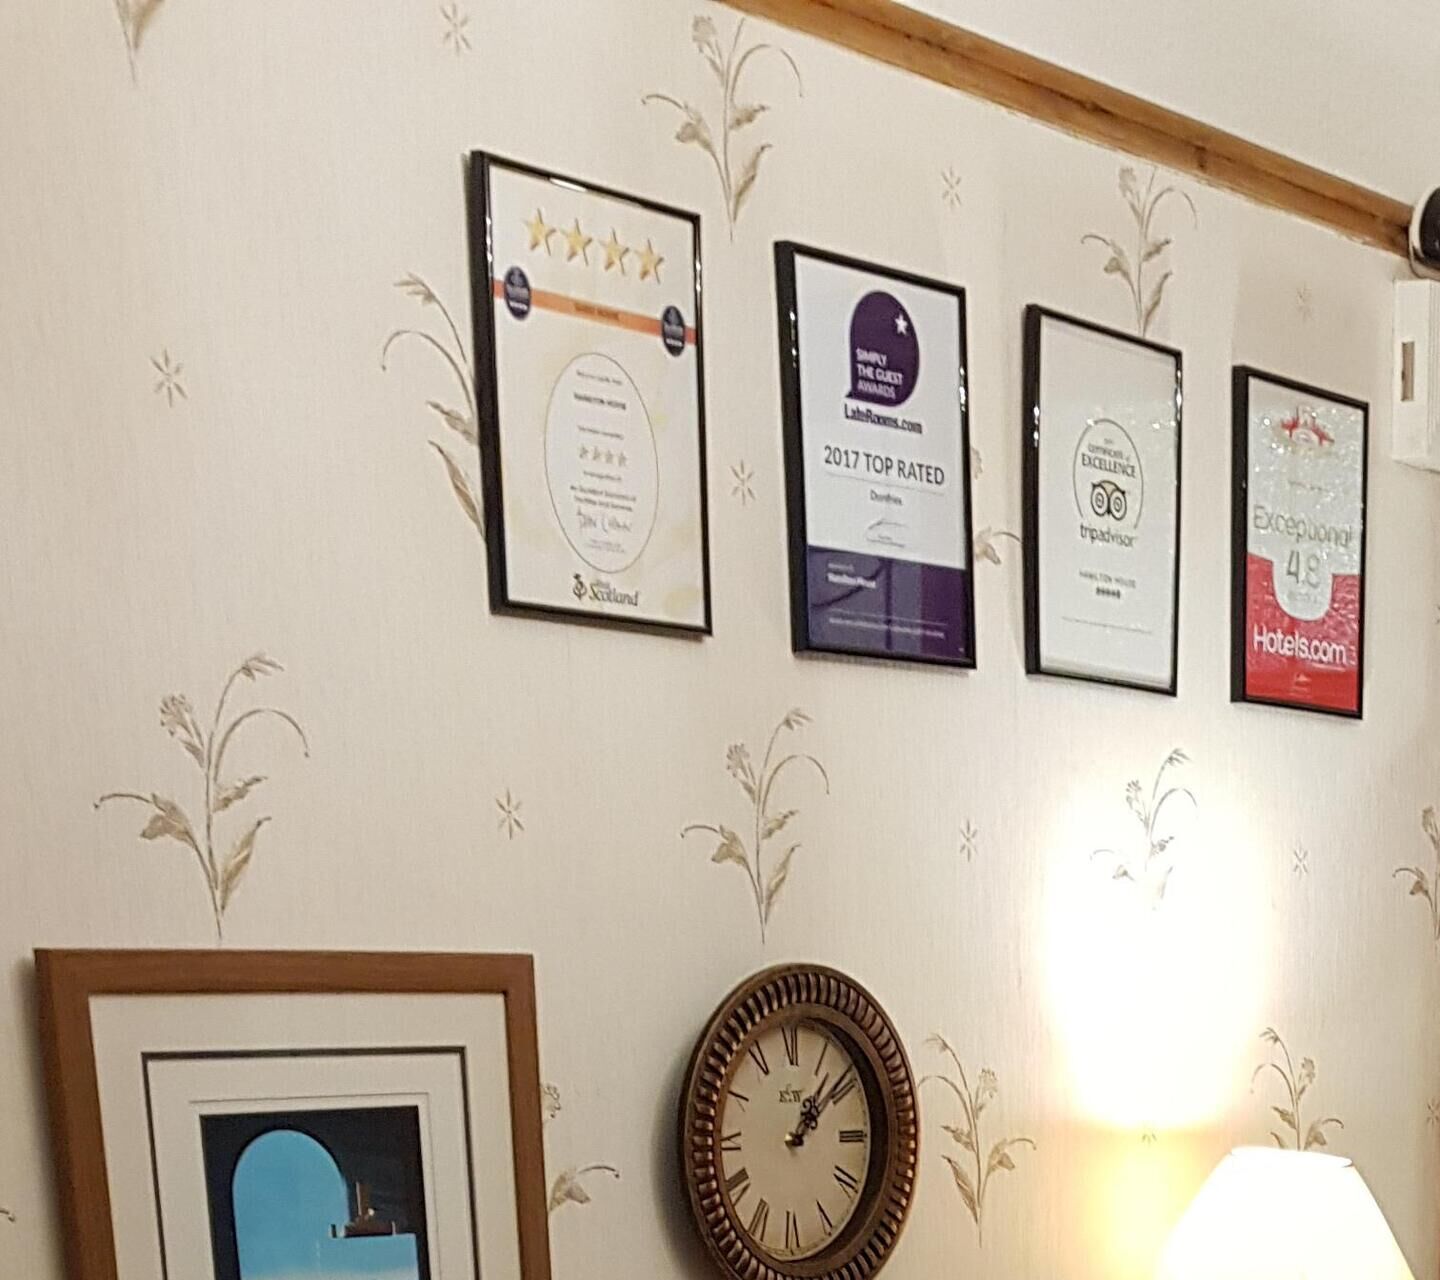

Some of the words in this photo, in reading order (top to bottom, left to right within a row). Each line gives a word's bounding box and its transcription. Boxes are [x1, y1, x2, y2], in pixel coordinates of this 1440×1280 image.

[857, 364, 875, 380] THE
[844, 403, 923, 434] LateRooms.com
[824, 445, 859, 468] 2017
[862, 453, 894, 476] TOP
[897, 459, 945, 485] RATED
[1081, 452, 1136, 478] EXCELLENCE
[1079, 522, 1135, 547] tripadvisor
[1254, 503, 1353, 548] Exceptional
[1286, 550, 1321, 589] 4.8
[588, 583, 639, 606] Scotland
[1253, 623, 1346, 665] Hotels.com
